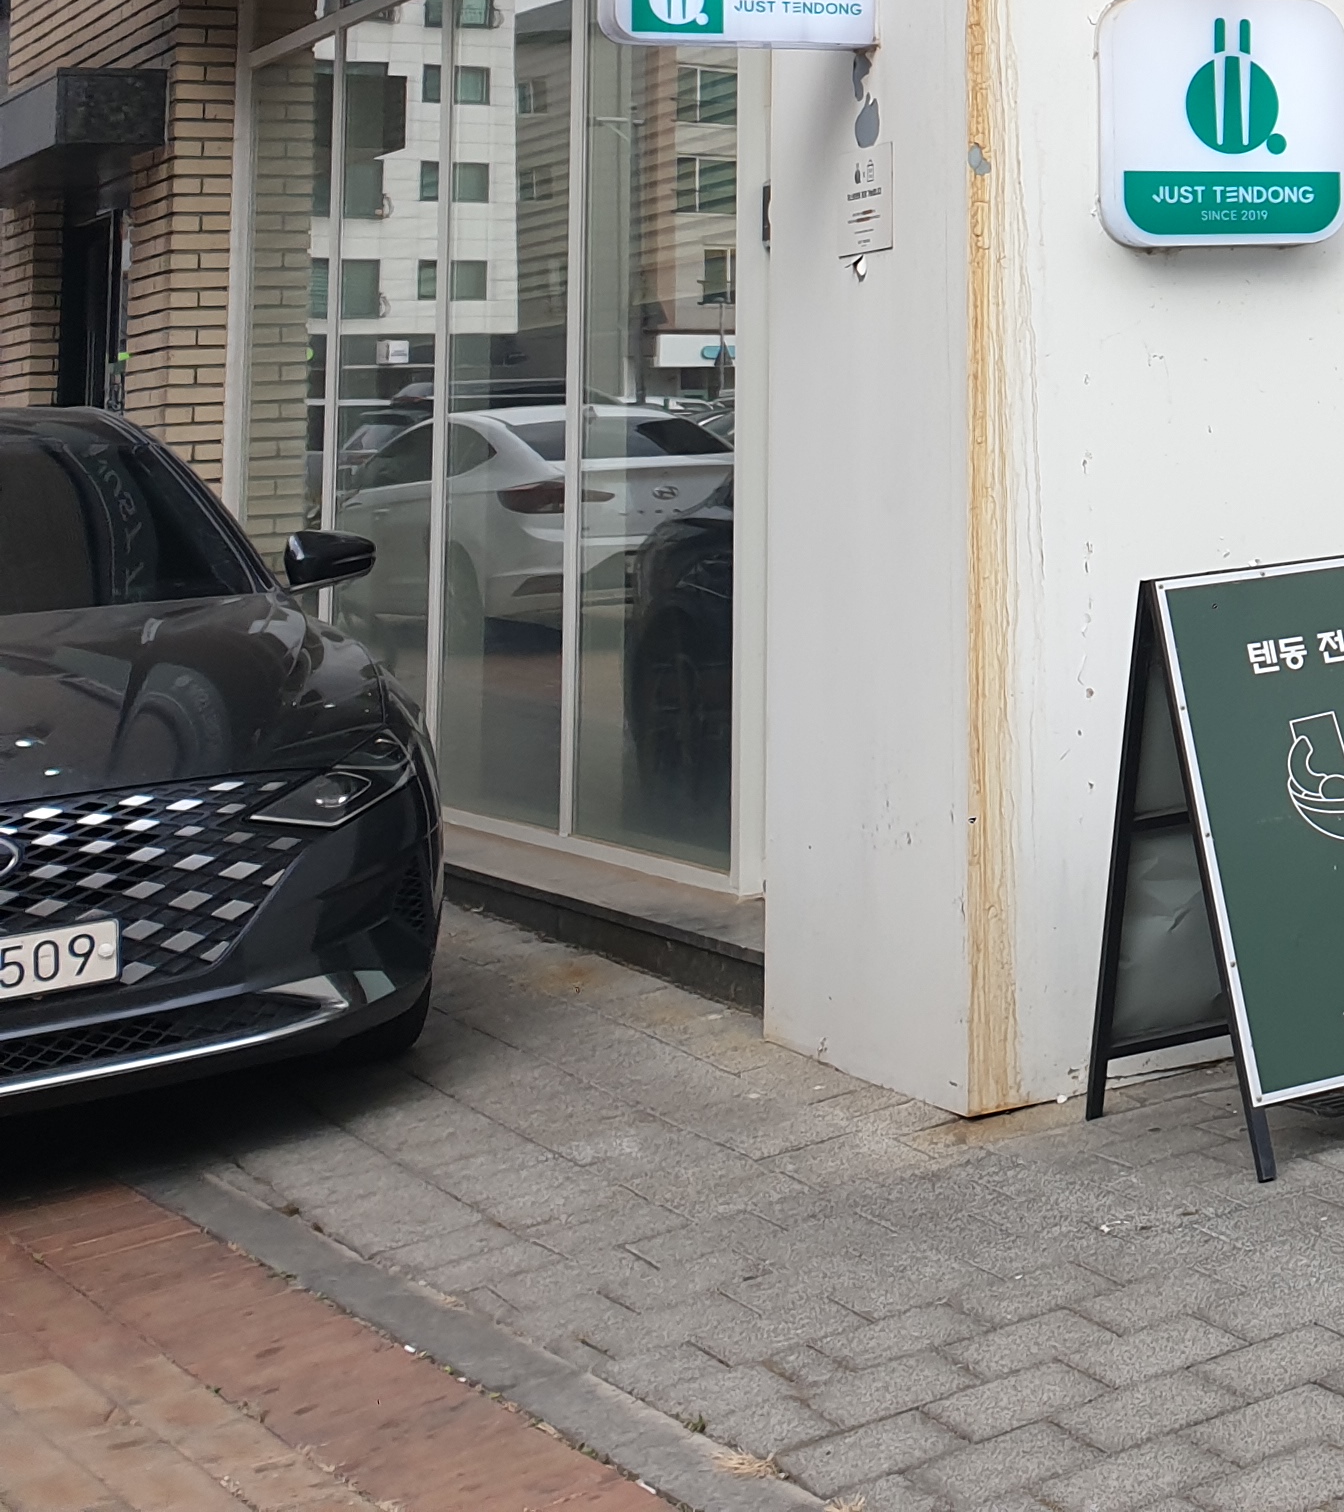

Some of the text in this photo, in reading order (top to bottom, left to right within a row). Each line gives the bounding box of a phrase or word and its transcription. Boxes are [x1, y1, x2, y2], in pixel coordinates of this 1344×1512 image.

[734, 0, 862, 15] JUST TENDONG
[1152, 186, 1315, 204] JUST TENDONG
[1201, 210, 1269, 221] SINCE 2019
[1247, 636, 1308, 675] 텐동
